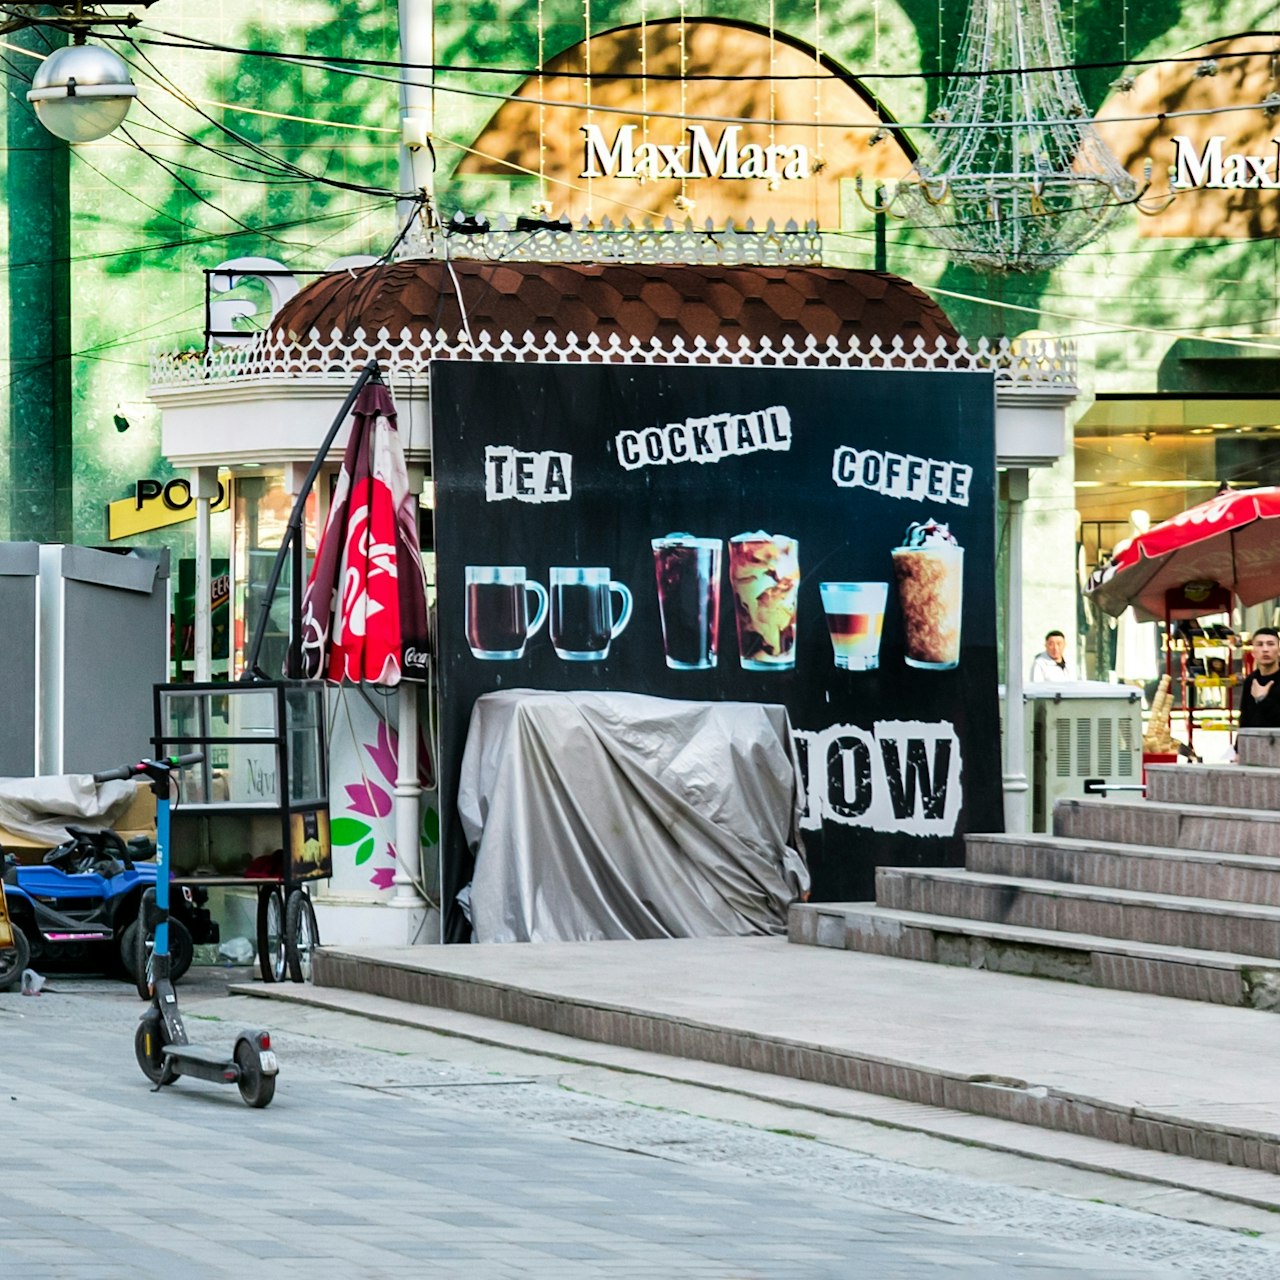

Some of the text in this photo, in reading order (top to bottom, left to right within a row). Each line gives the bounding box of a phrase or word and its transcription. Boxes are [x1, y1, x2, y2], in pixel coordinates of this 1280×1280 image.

[578, 124, 810, 180] MaxMara
[1170, 135, 1280, 191] Max
[619, 410, 790, 467] COCKTAIL
[487, 452, 570, 498] TEA
[837, 449, 970, 501] COFFEE
